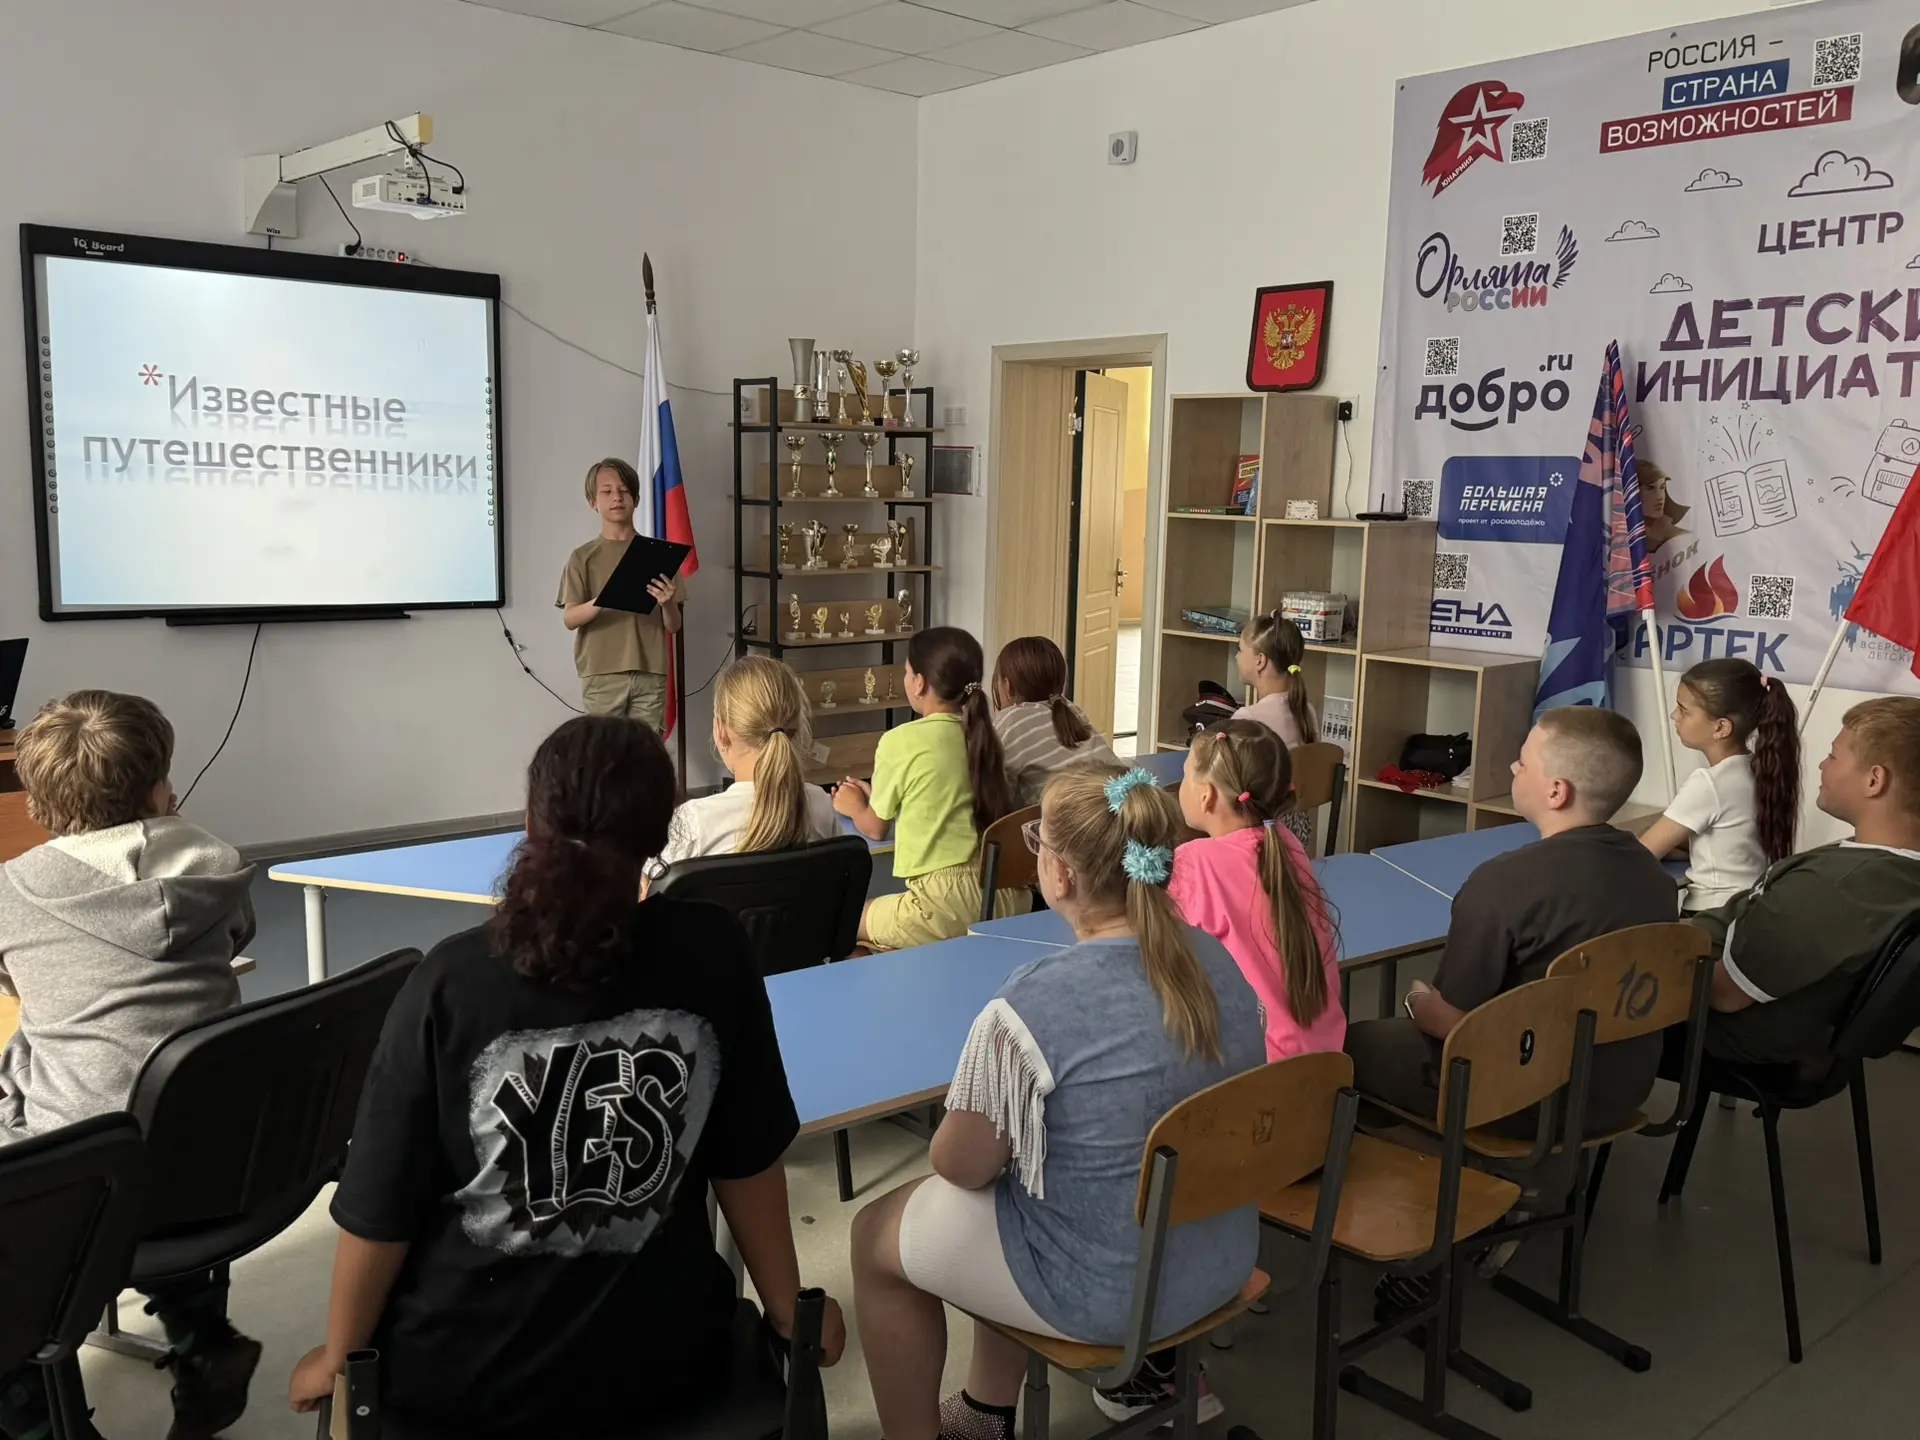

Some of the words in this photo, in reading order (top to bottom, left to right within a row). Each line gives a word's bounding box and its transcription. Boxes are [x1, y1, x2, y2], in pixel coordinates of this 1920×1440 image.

[1648, 34, 1756, 73] РОССИЯ
[1670, 68, 1777, 104] СТРАНА
[1607, 90, 1837, 148] ВОЗМОЖНОСТЕЙ
[1441, 155, 1474, 187] ЮНАРМИЯ
[92, 240, 125, 252] Board
[1757, 211, 1904, 255] ЦЕНТР
[1416, 231, 1551, 304] Орлята
[1447, 285, 1548, 313] РОССИИ
[1539, 354, 1573, 372] .ru
[168, 374, 406, 423] Известные
[1414, 367, 1570, 423] добро
[83, 436, 478, 479] путешественники
[1460, 499, 1544, 512] ПЕРЕМЕНА
[1463, 485, 1548, 498] БОЛЬШАЯ
[1444, 627, 1478, 635] детский
[1613, 959, 1660, 1020] 10
[1519, 1027, 1535, 1066] 9
[490, 1040, 688, 1222] YES
